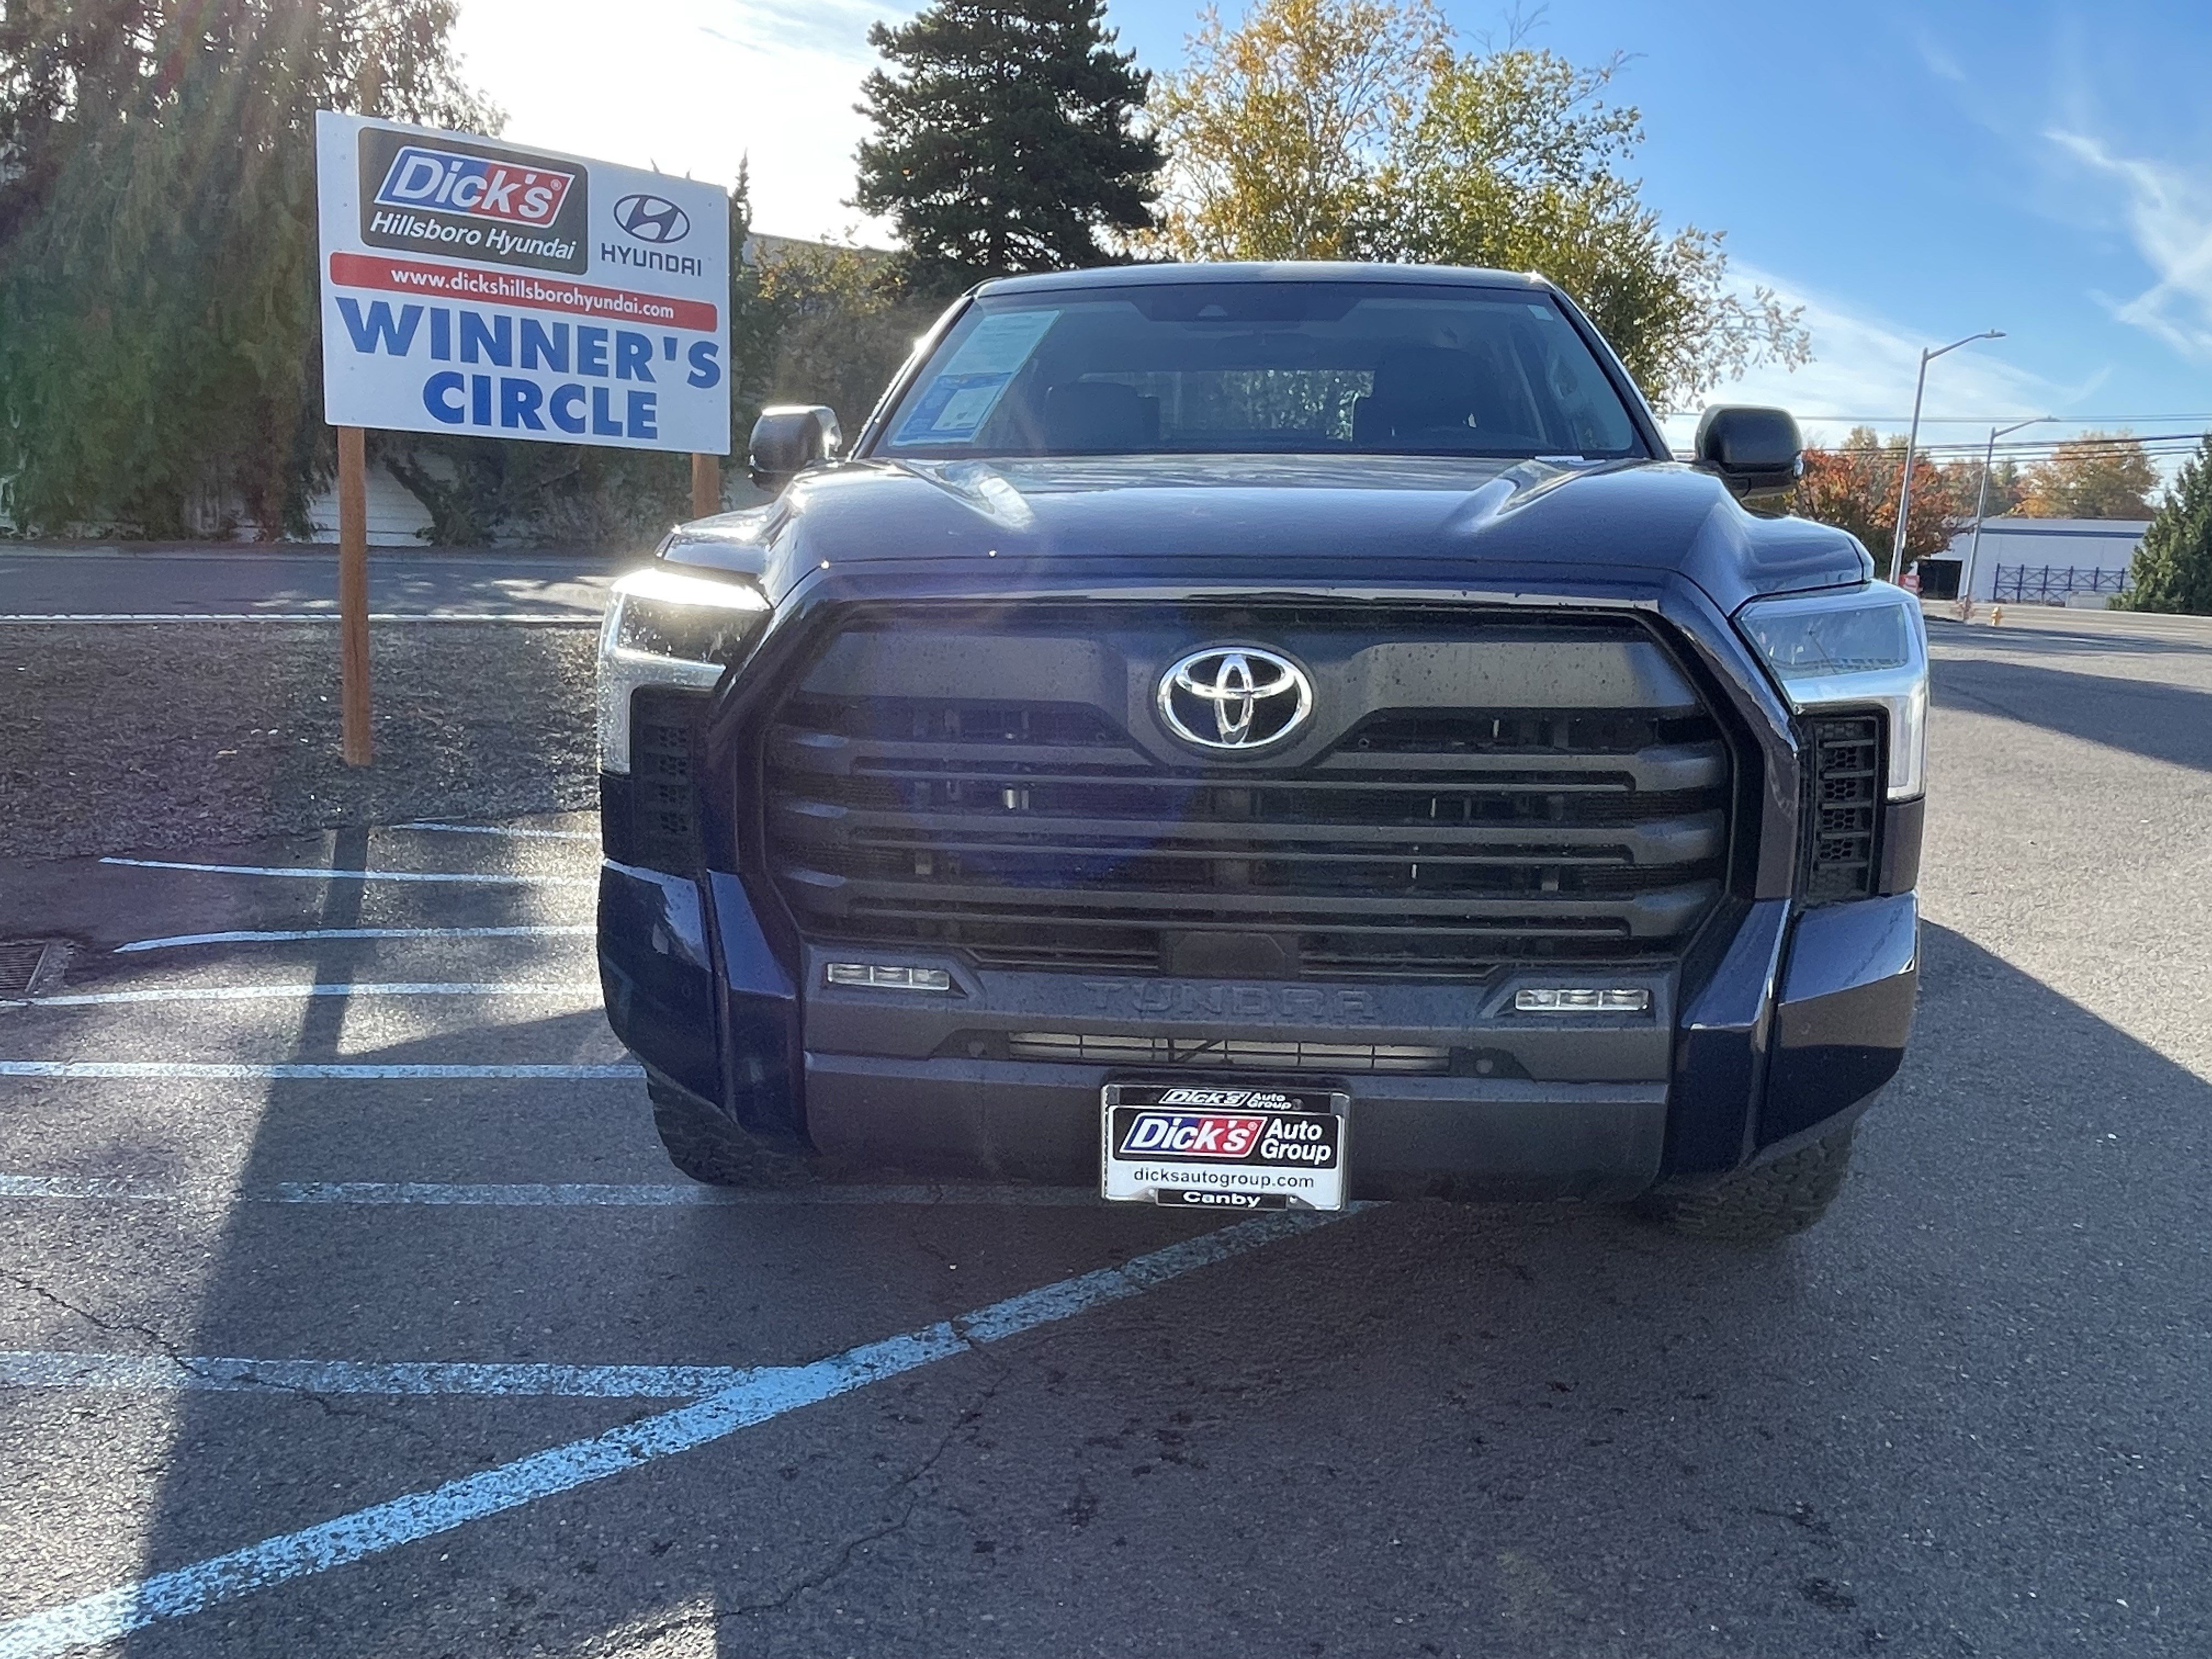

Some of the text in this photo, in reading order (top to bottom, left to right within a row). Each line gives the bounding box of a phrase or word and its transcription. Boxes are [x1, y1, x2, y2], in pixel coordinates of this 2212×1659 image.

[370, 212, 576, 260] Hillsboro Hyundai
[601, 242, 702, 276] HYUNDAI
[391, 269, 675, 319] www.dickshillsborohyundai.com
[335, 296, 721, 388] WINNER'S
[422, 371, 658, 439] CIRCLE
[1082, 982, 1378, 1019] TUNDRA
[1247, 1099, 1291, 1110] Group
[1252, 1092, 1285, 1101] Auto
[1264, 1119, 1323, 1141] Auto
[1261, 1138, 1331, 1165] Group
[1133, 1167, 1314, 1189] dicksautogroup.com
[1183, 1192, 1260, 1207] Canby
